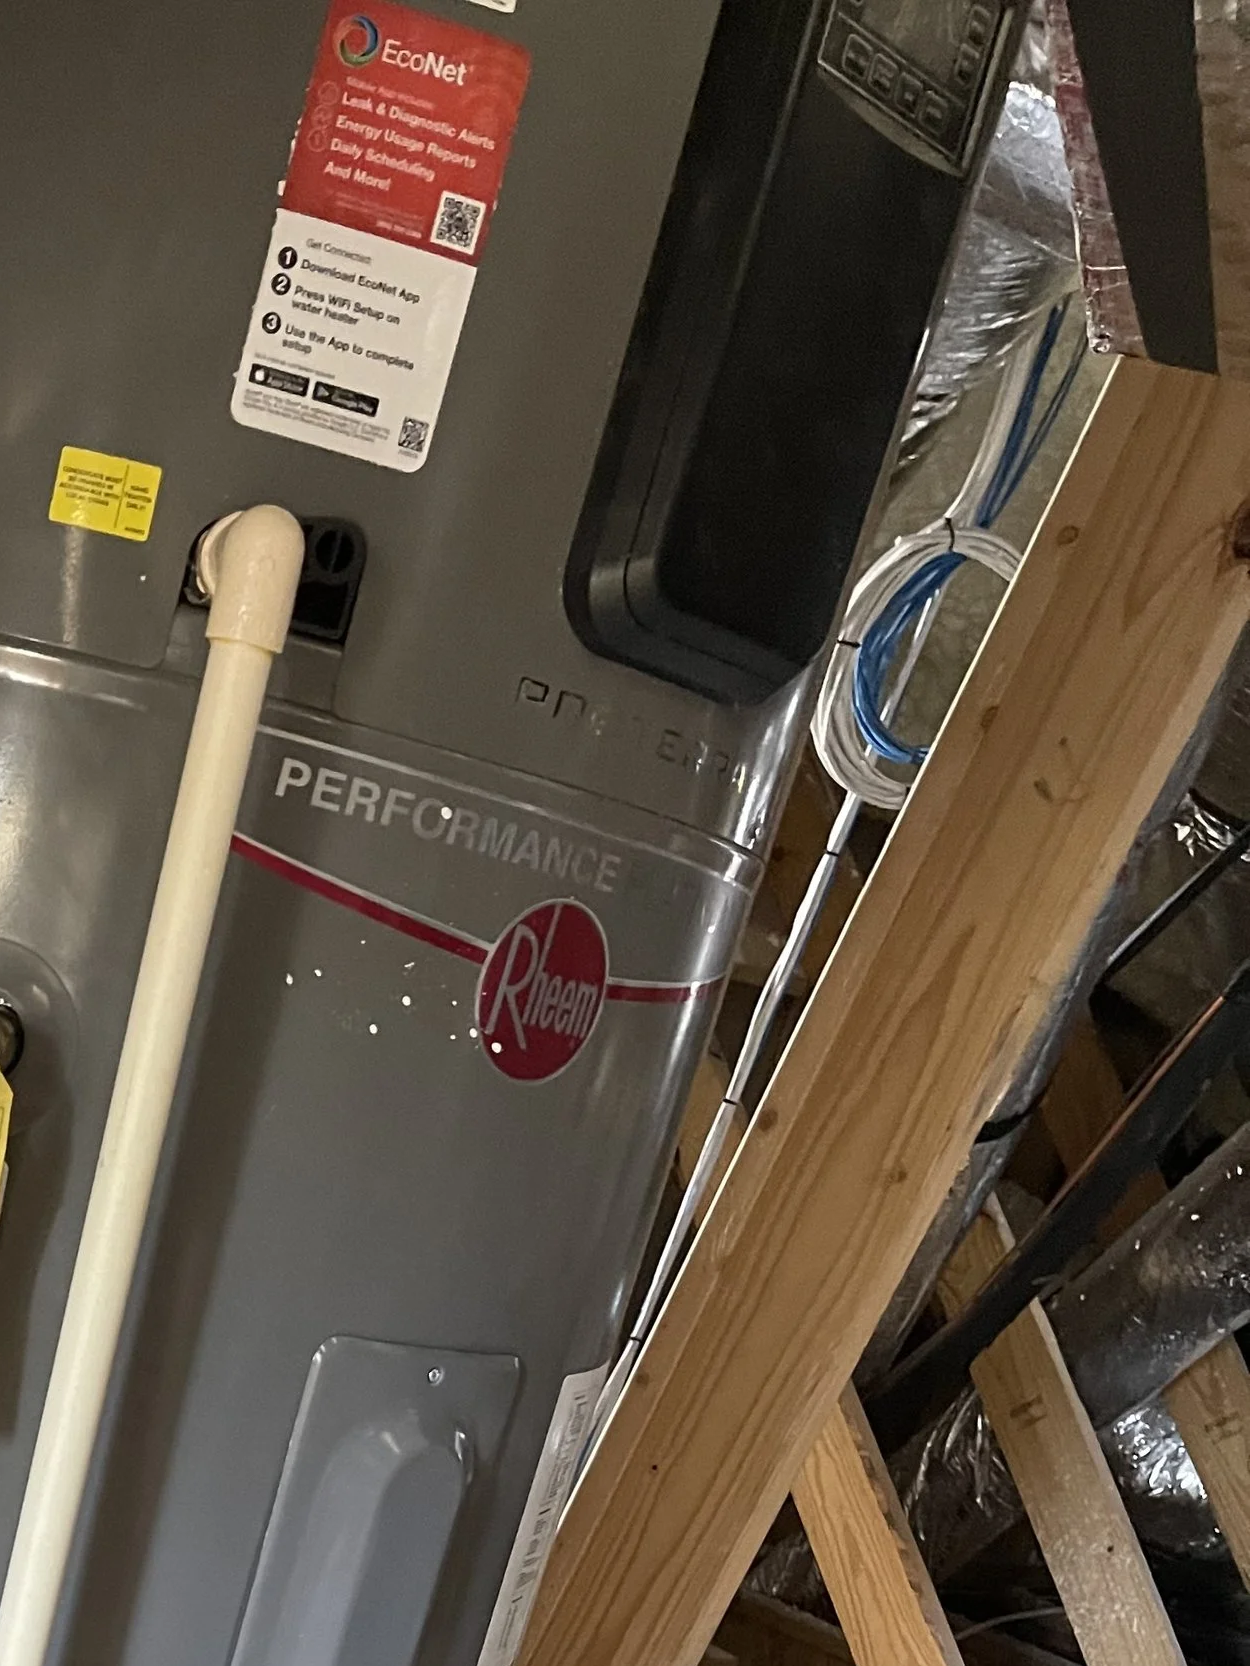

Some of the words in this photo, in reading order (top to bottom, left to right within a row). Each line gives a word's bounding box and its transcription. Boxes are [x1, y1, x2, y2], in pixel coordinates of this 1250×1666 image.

[381, 38, 467, 85] EcoNet
[335, 115, 382, 140] Energy
[383, 129, 425, 154] Usage
[426, 142, 476, 168] Reports
[341, 92, 373, 111] Leak
[376, 101, 386, 115] &
[388, 106, 456, 137] Diagnostic
[458, 128, 495, 149] Alerts
[324, 161, 351, 178] And
[330, 138, 362, 159] Daily
[365, 149, 435, 181] Scheduling
[301, 258, 355, 283] Download
[357, 276, 396, 295] EcoNet
[398, 289, 419, 303] App
[292, 299, 321, 314] water
[324, 309, 357, 325] heater
[295, 286, 324, 301] Press
[353, 303, 384, 320] Setup
[385, 314, 400, 325] on
[282, 338, 311, 354] setup
[285, 324, 305, 337] Use
[308, 330, 326, 344] the
[328, 337, 349, 351] App
[351, 343, 363, 355] to
[365, 348, 413, 371] complete
[276, 758, 620, 892] PERFORMANCE
[486, 904, 597, 1051] Rheem
